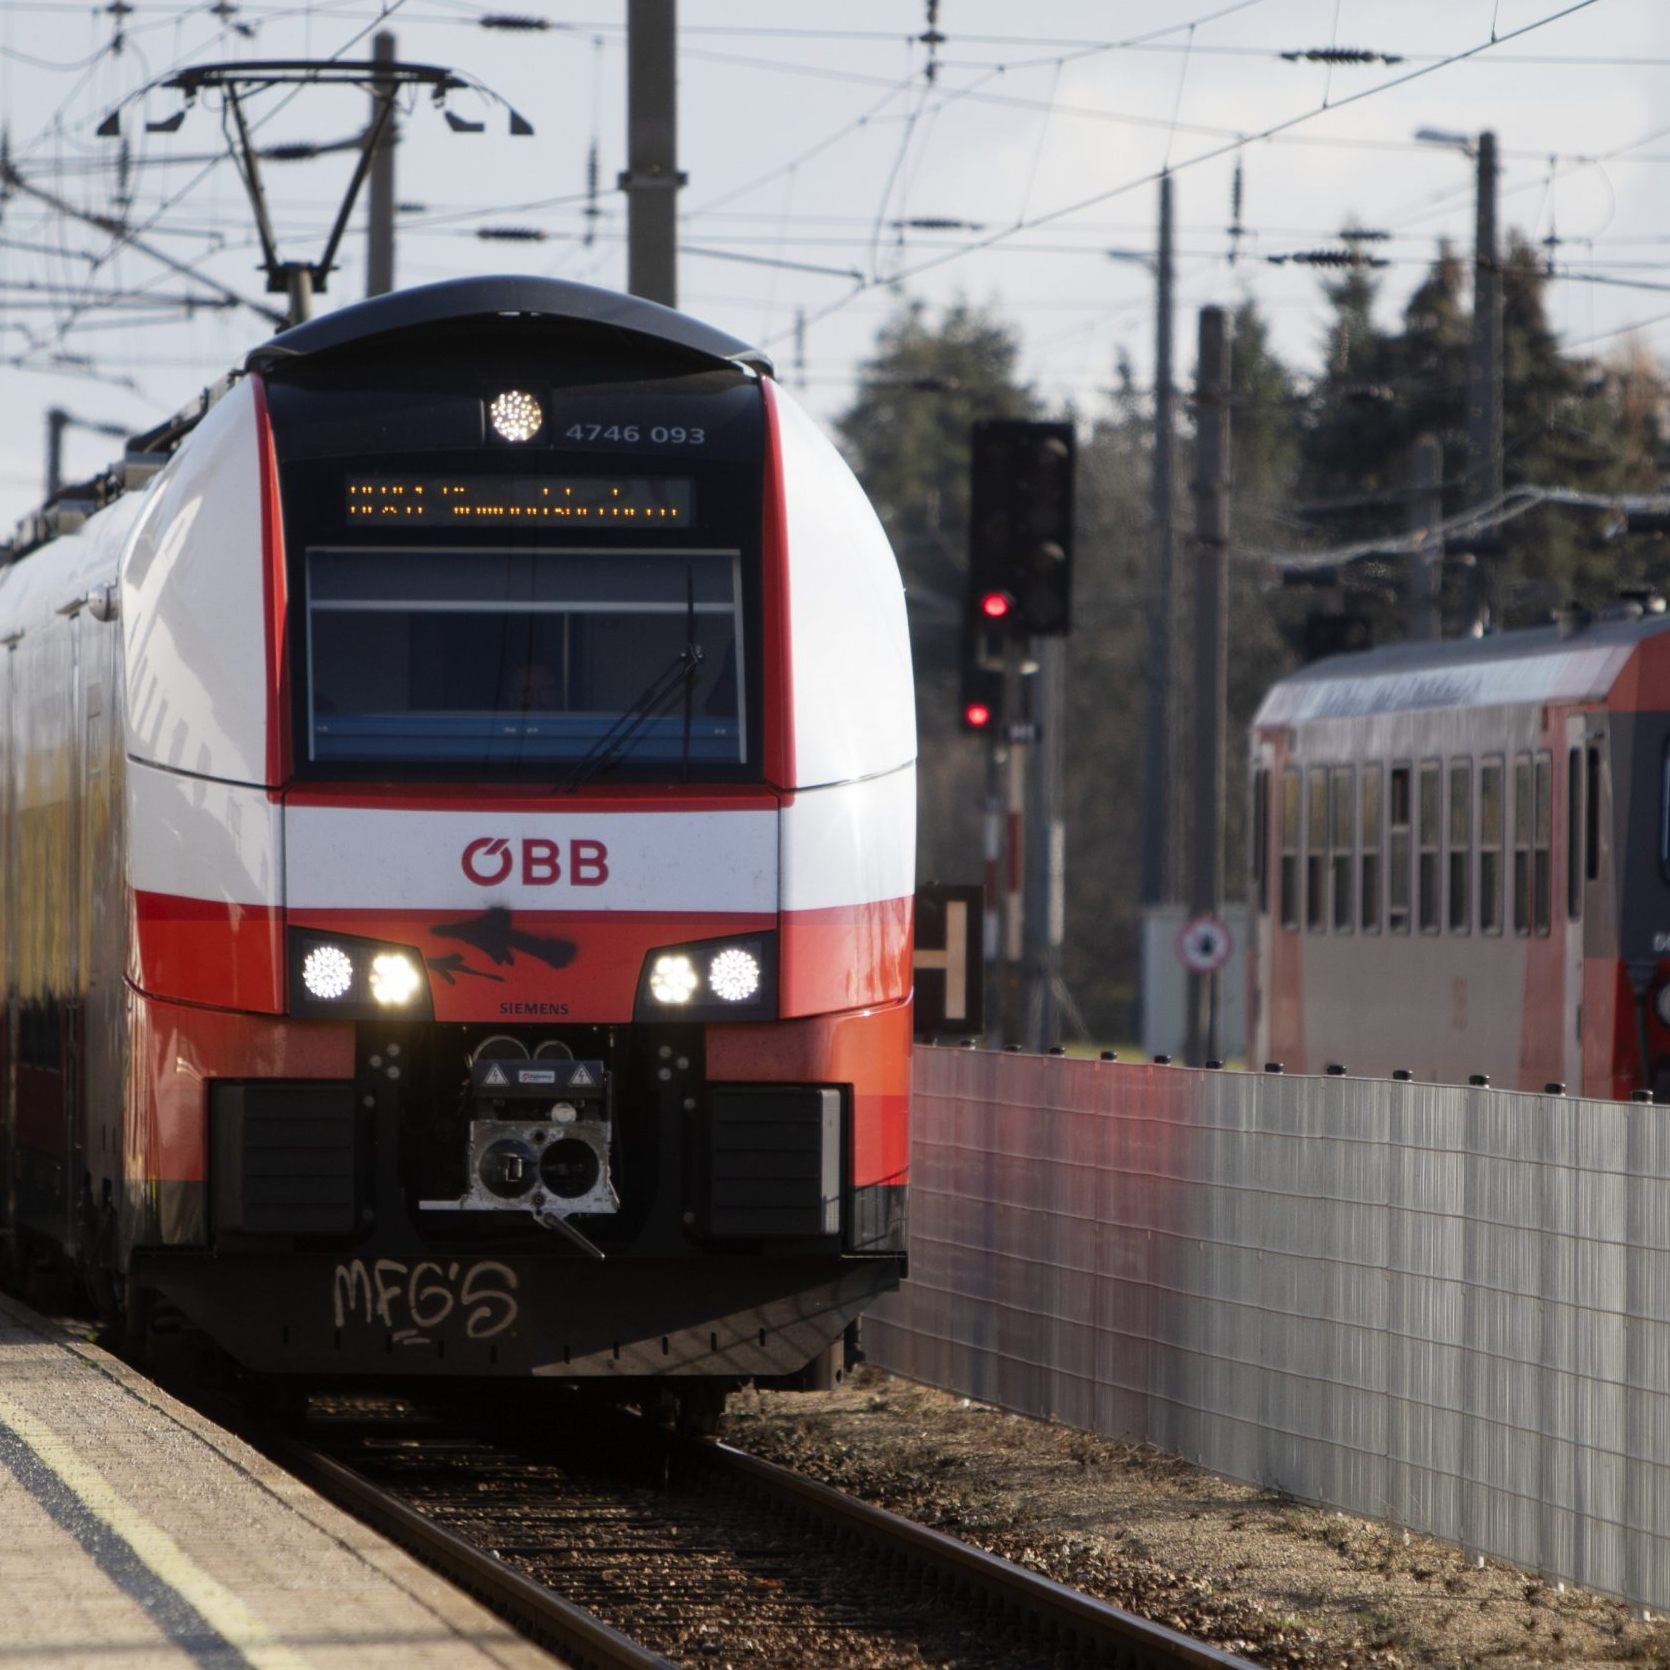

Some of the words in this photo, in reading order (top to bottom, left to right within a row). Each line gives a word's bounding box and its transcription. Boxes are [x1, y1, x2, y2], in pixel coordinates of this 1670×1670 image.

[565, 423, 641, 442] 4746
[650, 426, 706, 445] 093
[461, 837, 609, 886] ÖBB
[500, 1002, 569, 1016] SIEMENS
